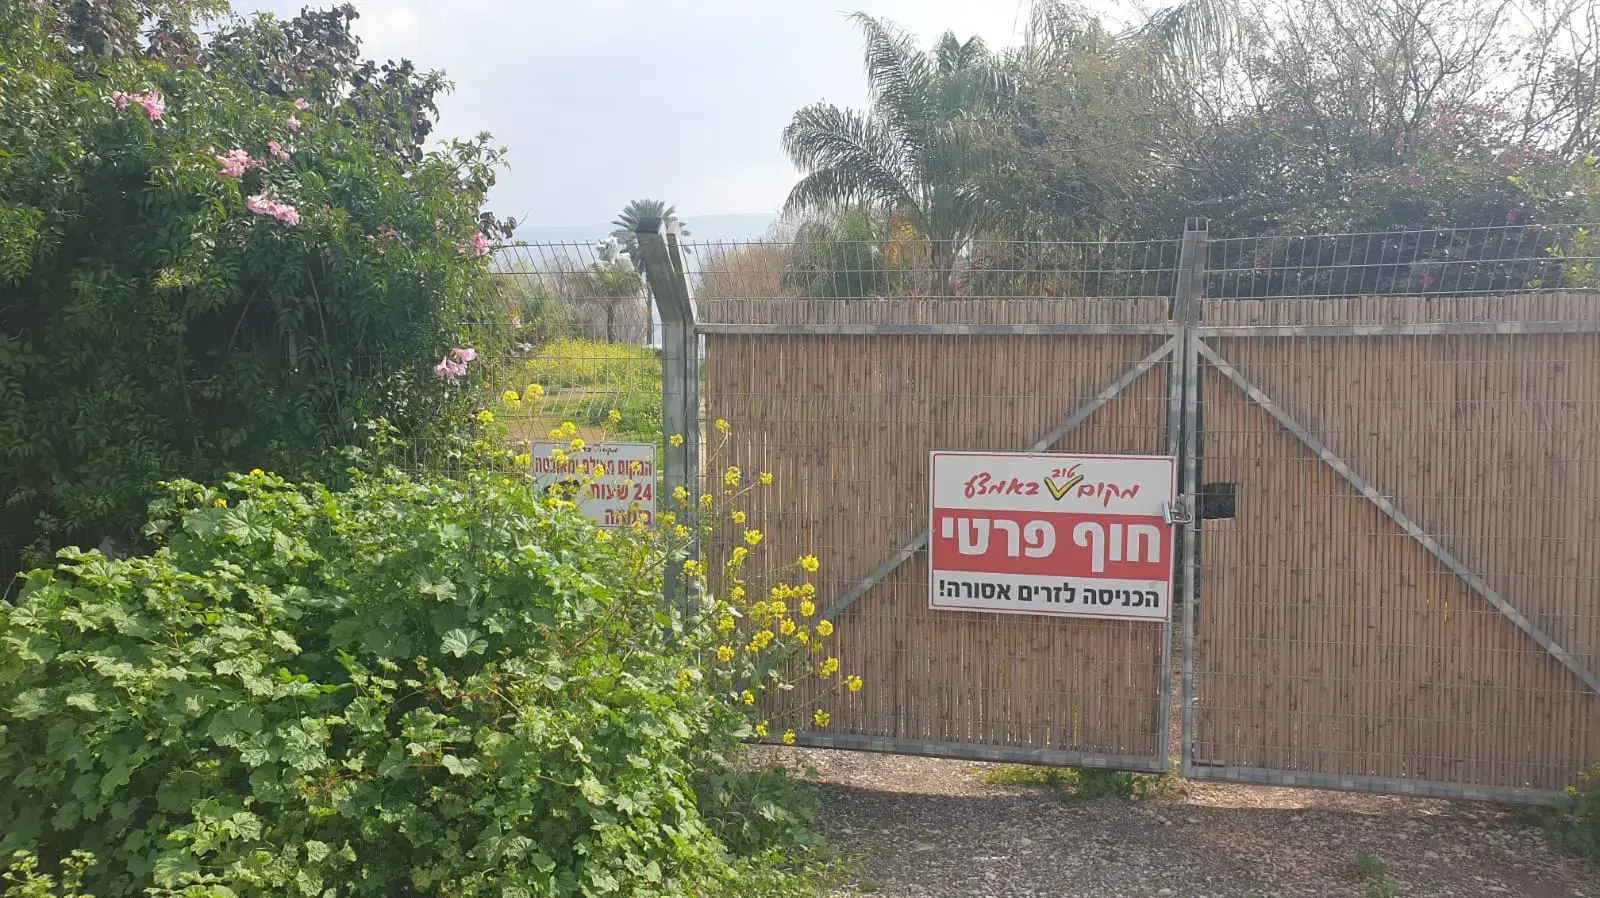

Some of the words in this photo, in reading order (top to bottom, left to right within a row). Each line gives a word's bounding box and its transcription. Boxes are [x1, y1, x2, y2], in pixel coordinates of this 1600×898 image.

[618, 459, 652, 478] המקום
[1051, 464, 1083, 479] טוב
[591, 483, 629, 500] שעות
[634, 483, 652, 500] 24
[964, 472, 1040, 498] באמצע
[1077, 482, 1139, 508] מקום
[941, 517, 1056, 558] פרטי
[1072, 521, 1161, 573] חוף
[939, 580, 1011, 601] אסורה!
[1018, 582, 1076, 604] לזרים
[1083, 588, 1159, 608] הכניסה
